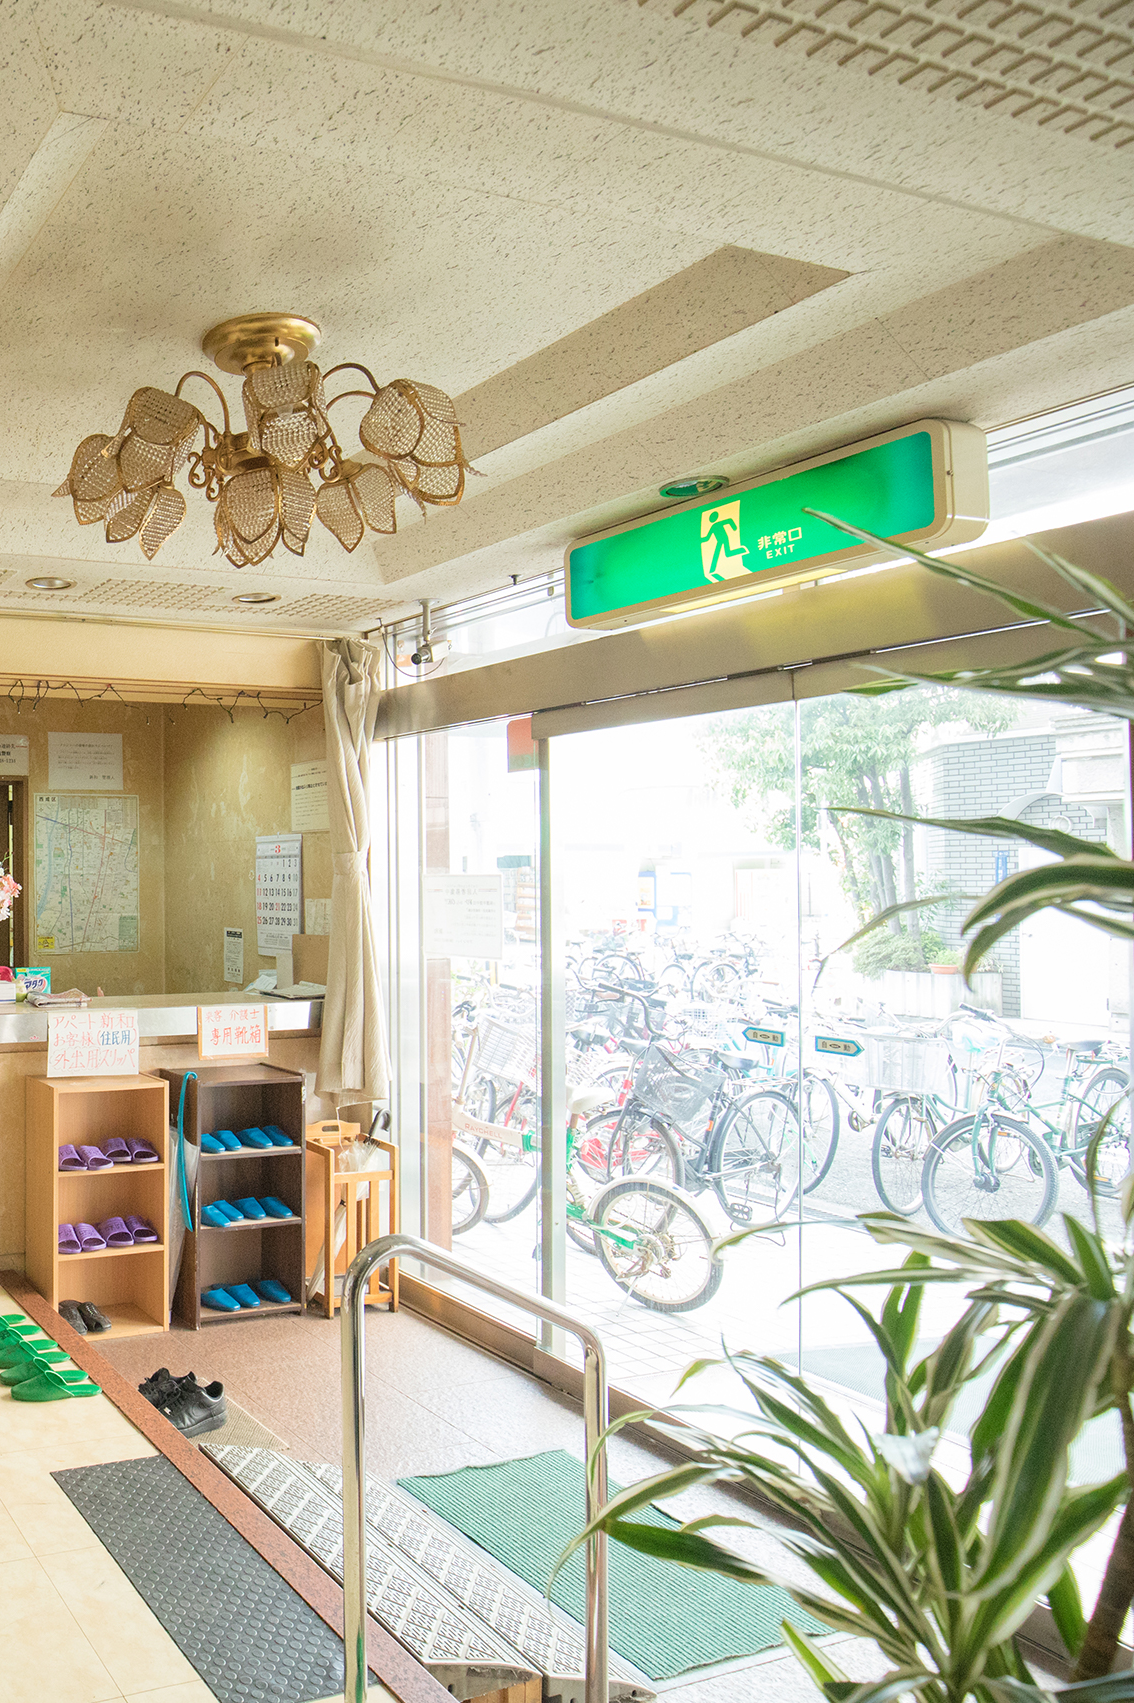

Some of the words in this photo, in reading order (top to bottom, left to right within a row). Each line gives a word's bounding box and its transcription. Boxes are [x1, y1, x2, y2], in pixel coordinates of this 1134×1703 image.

[758, 526, 802, 550] 非常口
[766, 544, 795, 560] EXIT
[275, 845, 281, 854] 3
[465, 1123, 502, 1139] RAYCHELL
